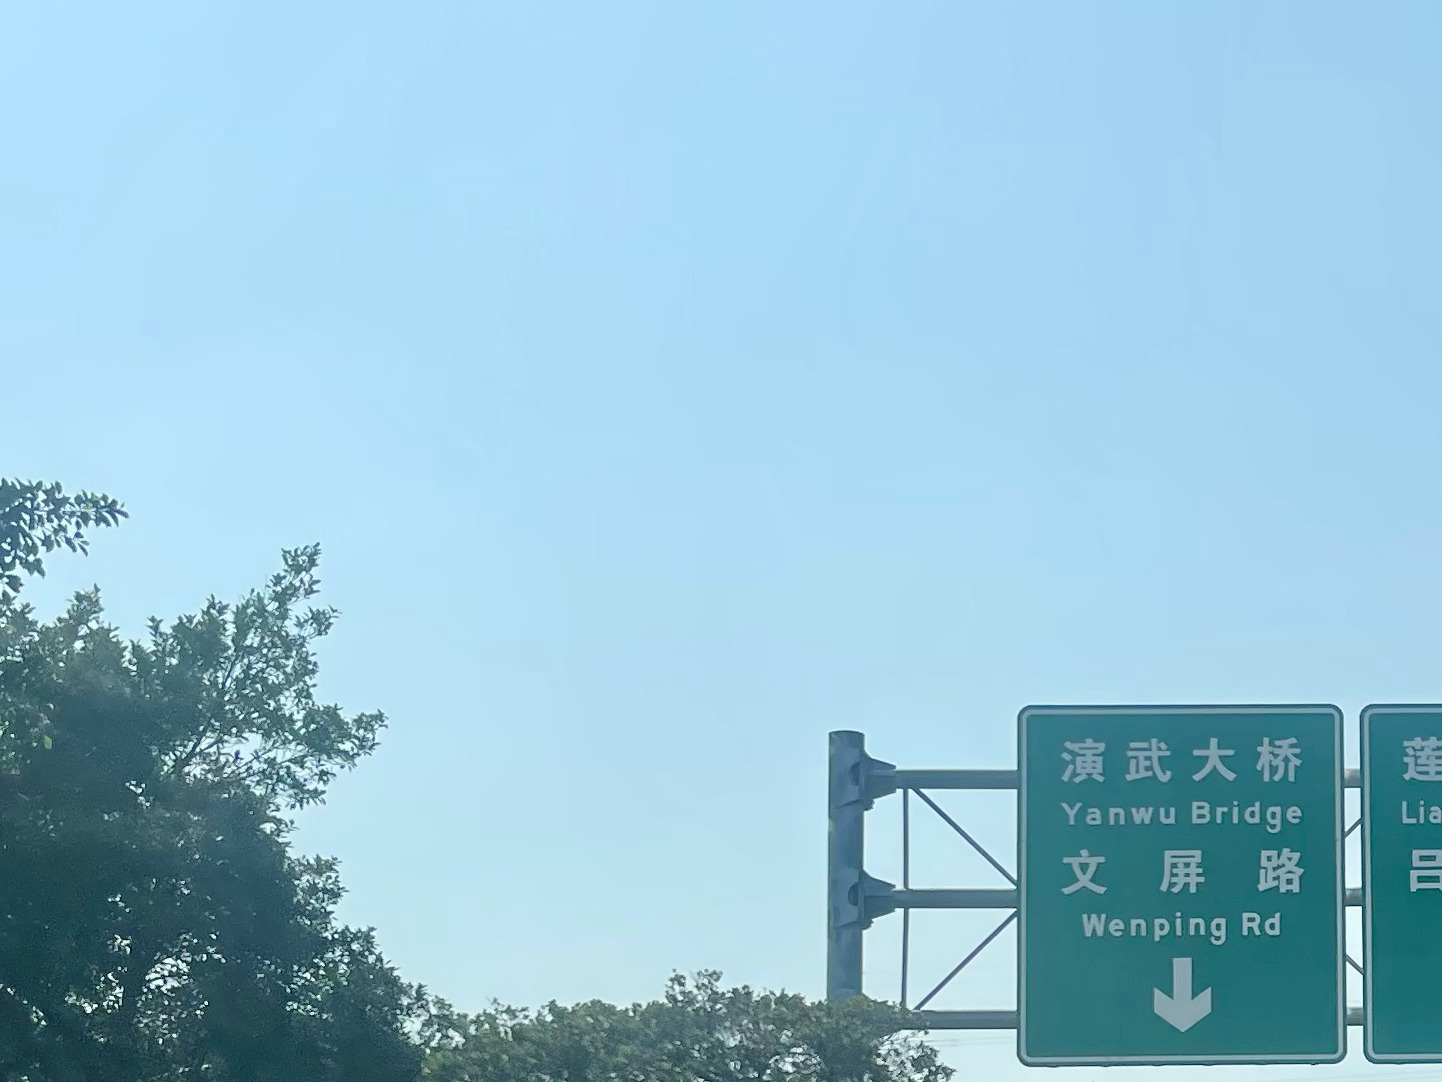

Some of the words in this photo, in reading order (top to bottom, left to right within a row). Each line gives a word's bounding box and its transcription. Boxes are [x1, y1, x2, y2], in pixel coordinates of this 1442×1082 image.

[1060, 737, 1303, 784] 演武大桥
[1060, 802, 1176, 826] Yanwu
[1191, 801, 1303, 834] Bridge
[1060, 848, 1305, 895] 文屏路
[1082, 912, 1227, 945] Wenping
[1242, 912, 1281, 936] Rd
